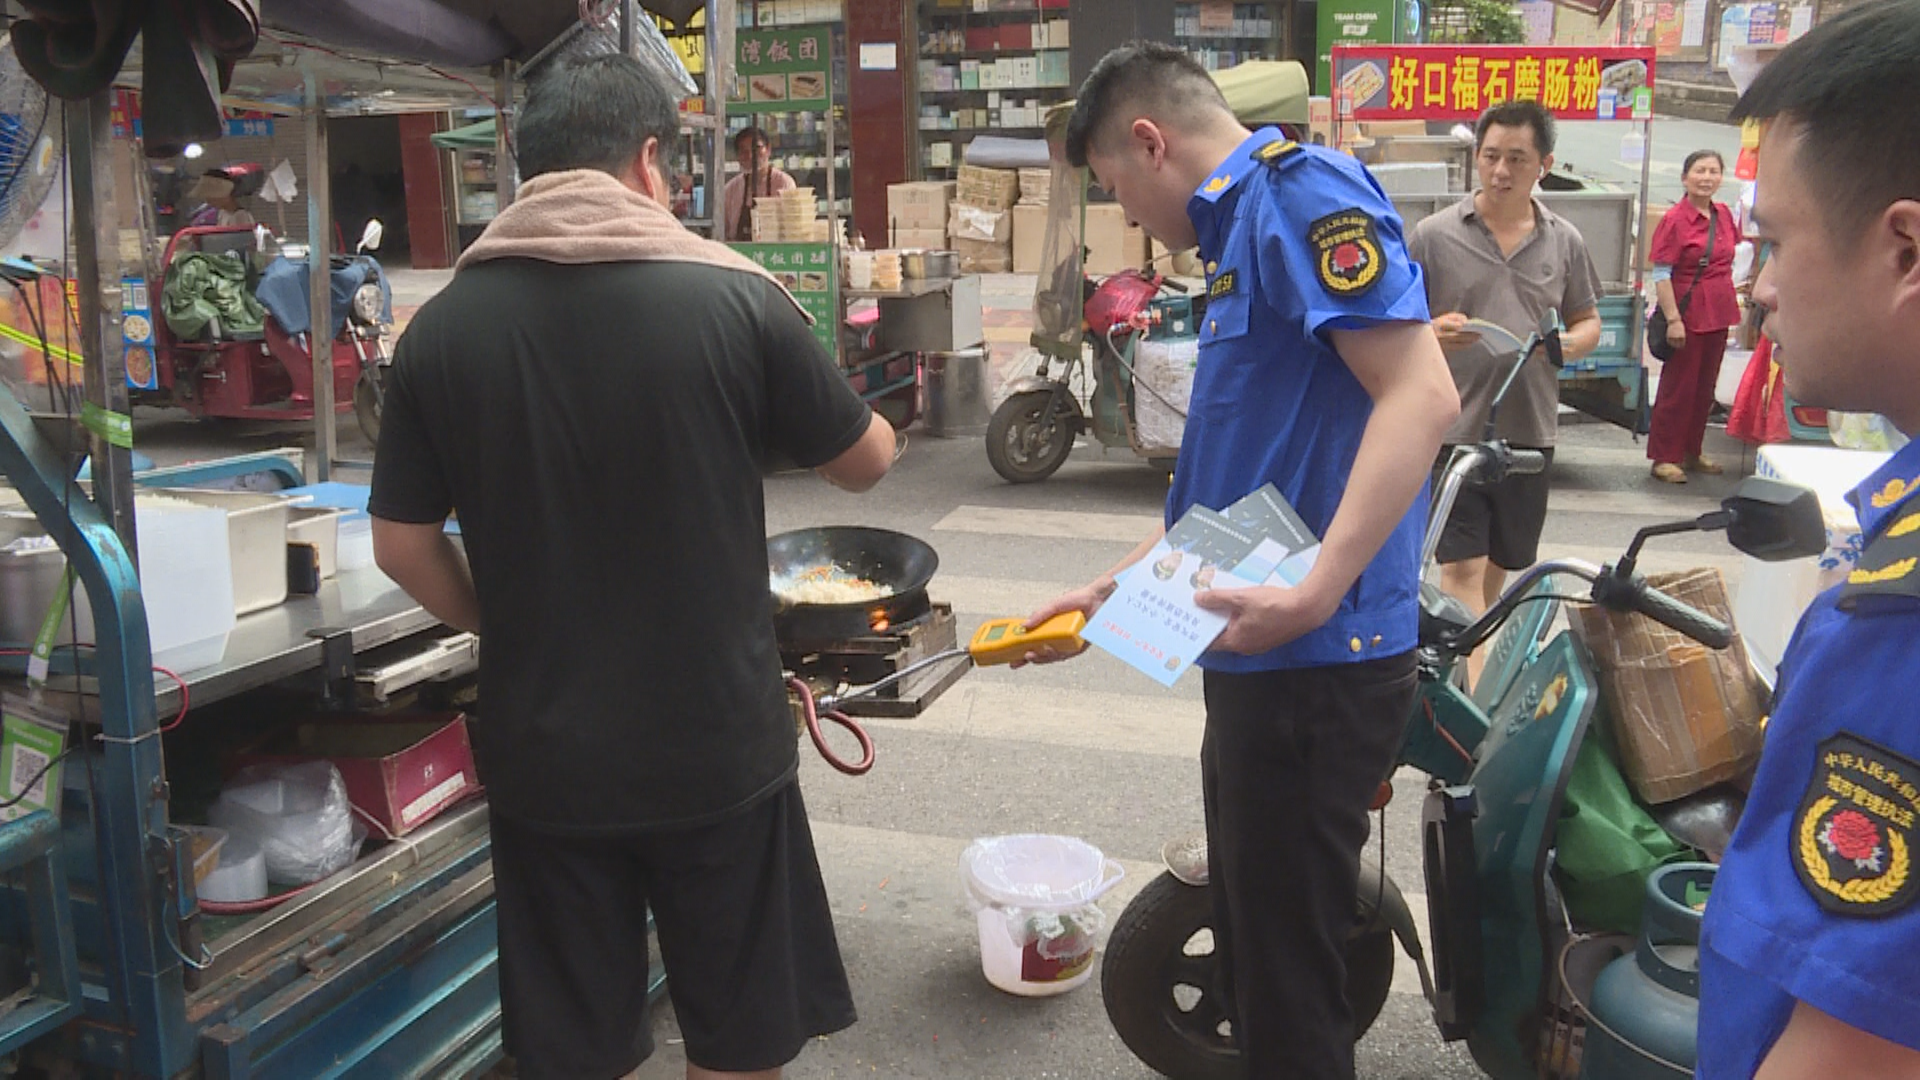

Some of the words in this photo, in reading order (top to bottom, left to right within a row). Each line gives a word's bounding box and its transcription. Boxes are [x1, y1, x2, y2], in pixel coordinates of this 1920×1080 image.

[740, 36, 819, 66] 湾饭团
[1390, 55, 1600, 111] 好口福石磨肠粉
[1826, 772, 1915, 829] 城市管理执法
